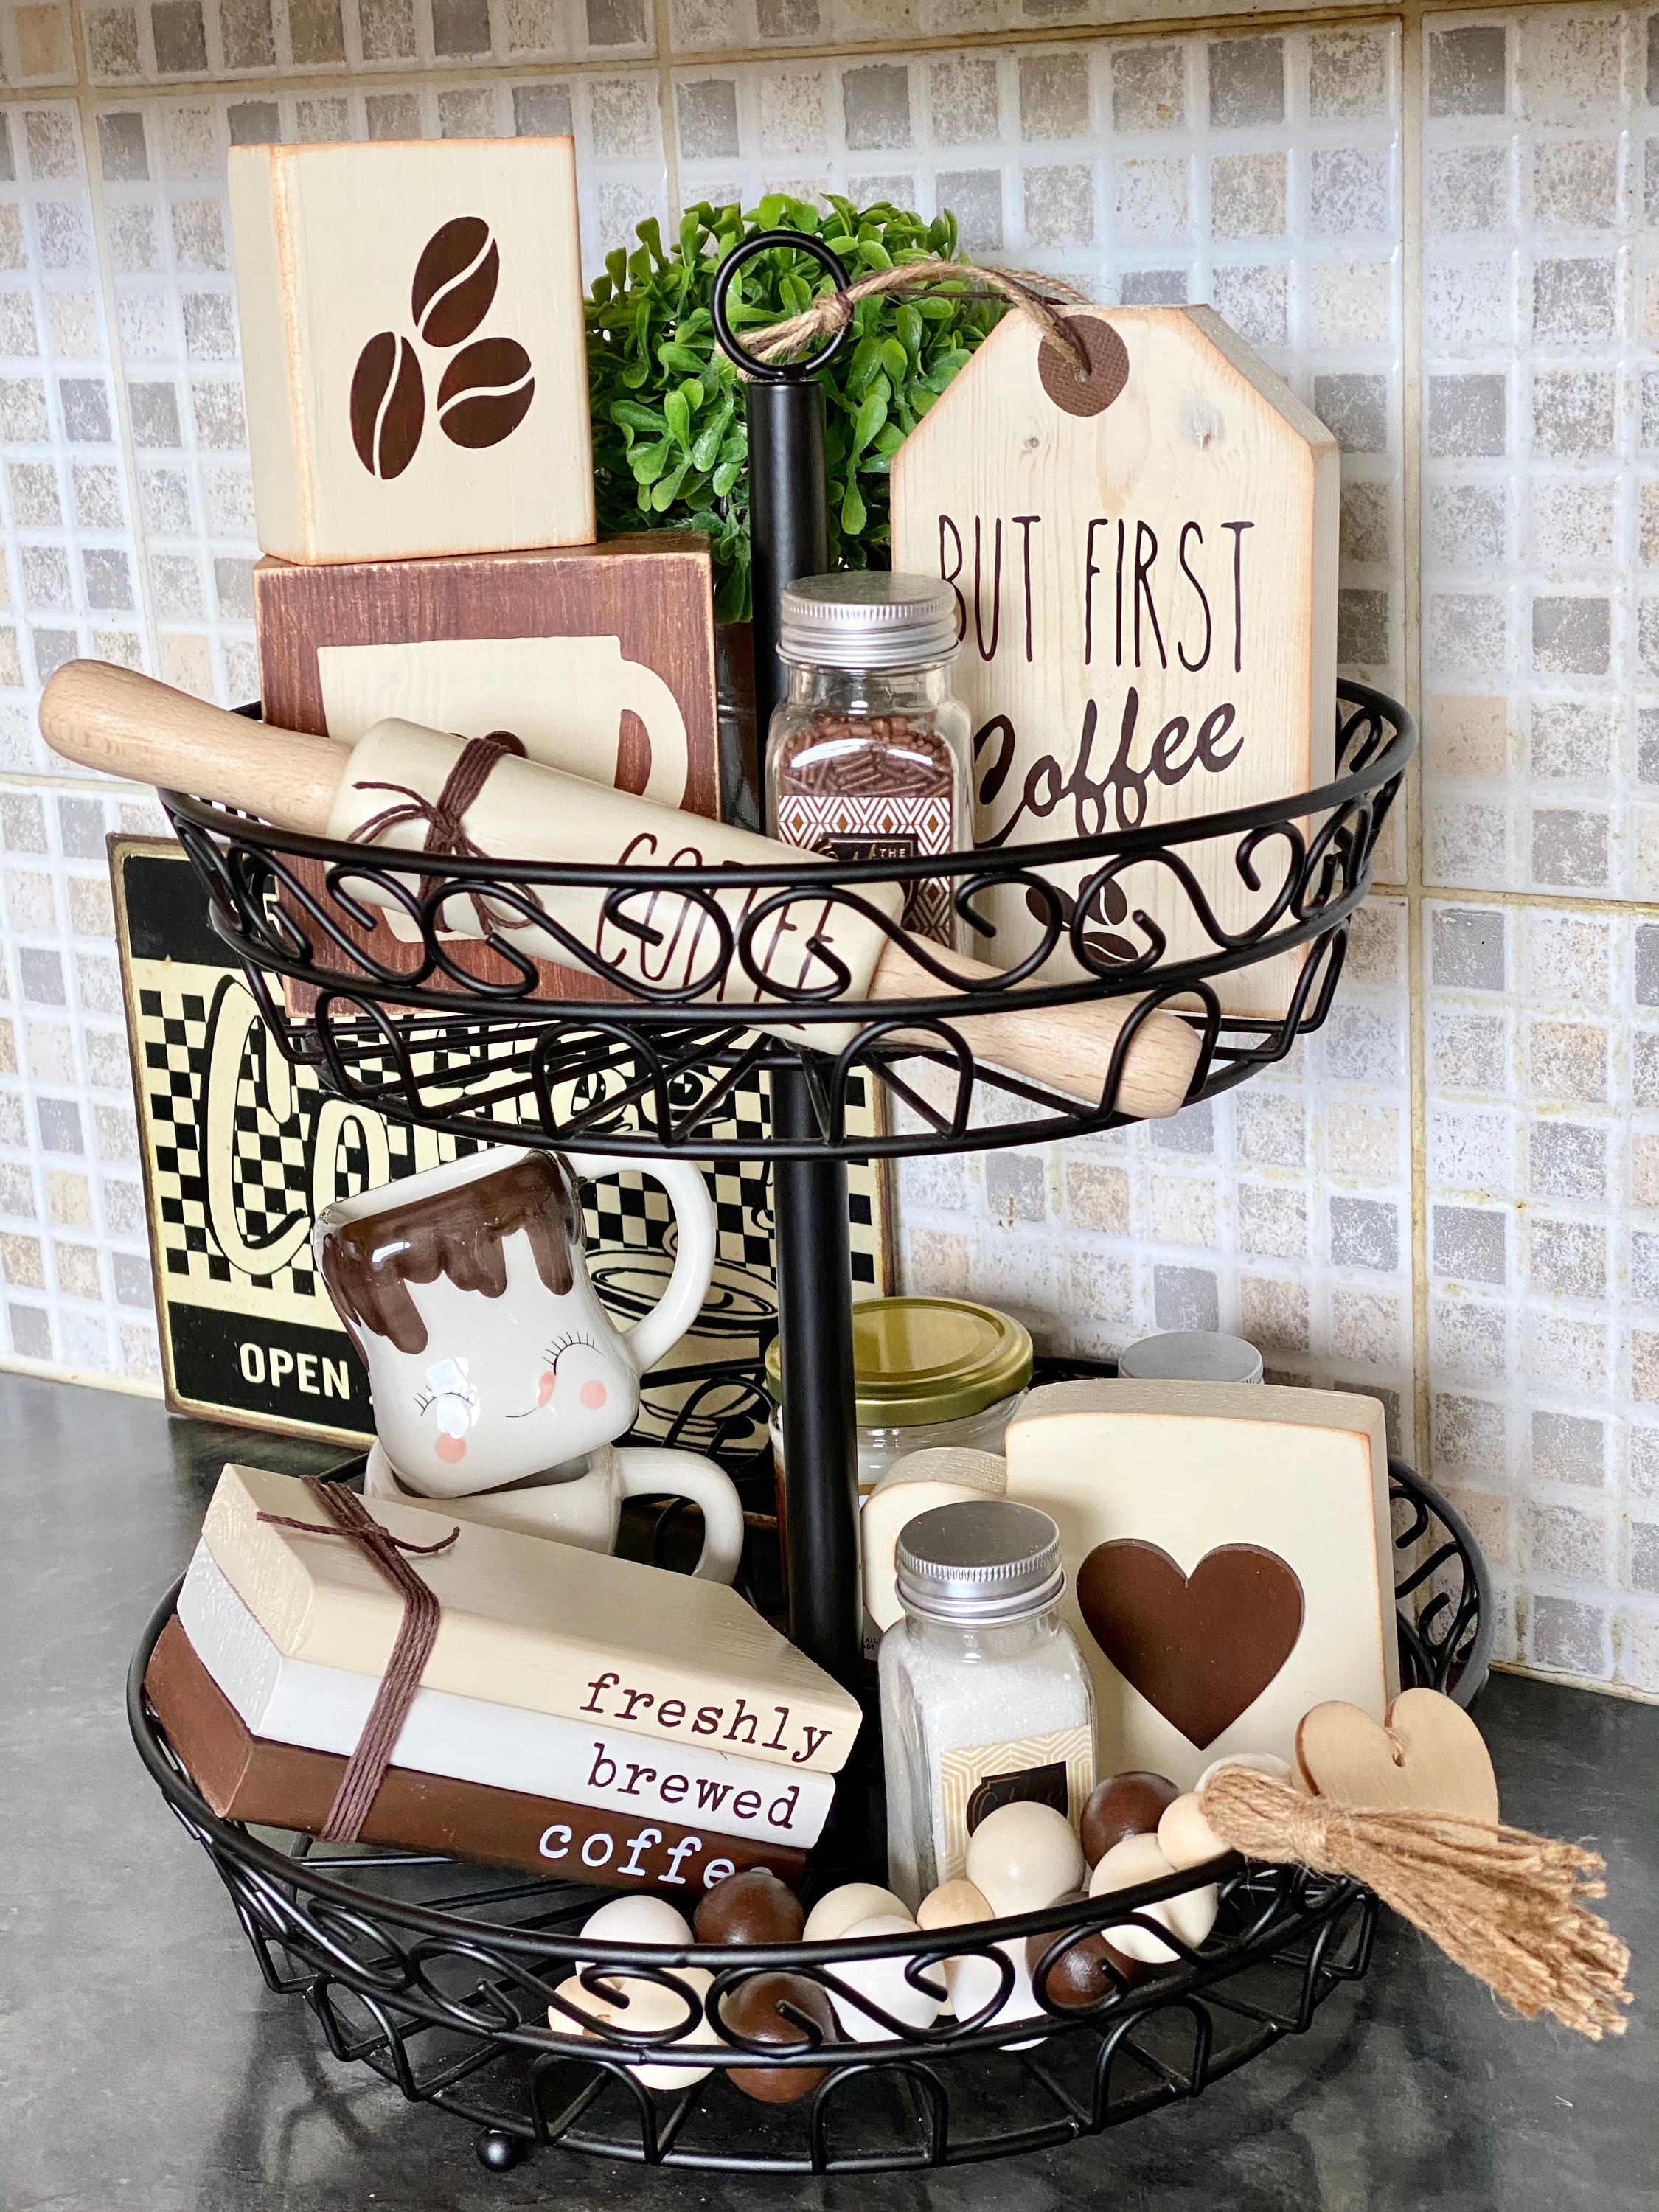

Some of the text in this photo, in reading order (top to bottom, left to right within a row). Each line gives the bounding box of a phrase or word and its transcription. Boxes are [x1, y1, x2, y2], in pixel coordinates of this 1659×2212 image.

[939, 514, 1254, 674] BUT FIRST
[974, 686, 1245, 849] Coffee
[879, 848, 906, 858] THE
[240, 1342, 350, 1400] OPEN
[579, 1672, 833, 1763] freshly
[588, 1742, 801, 1829] brewed
[539, 1823, 736, 1890] coffe
